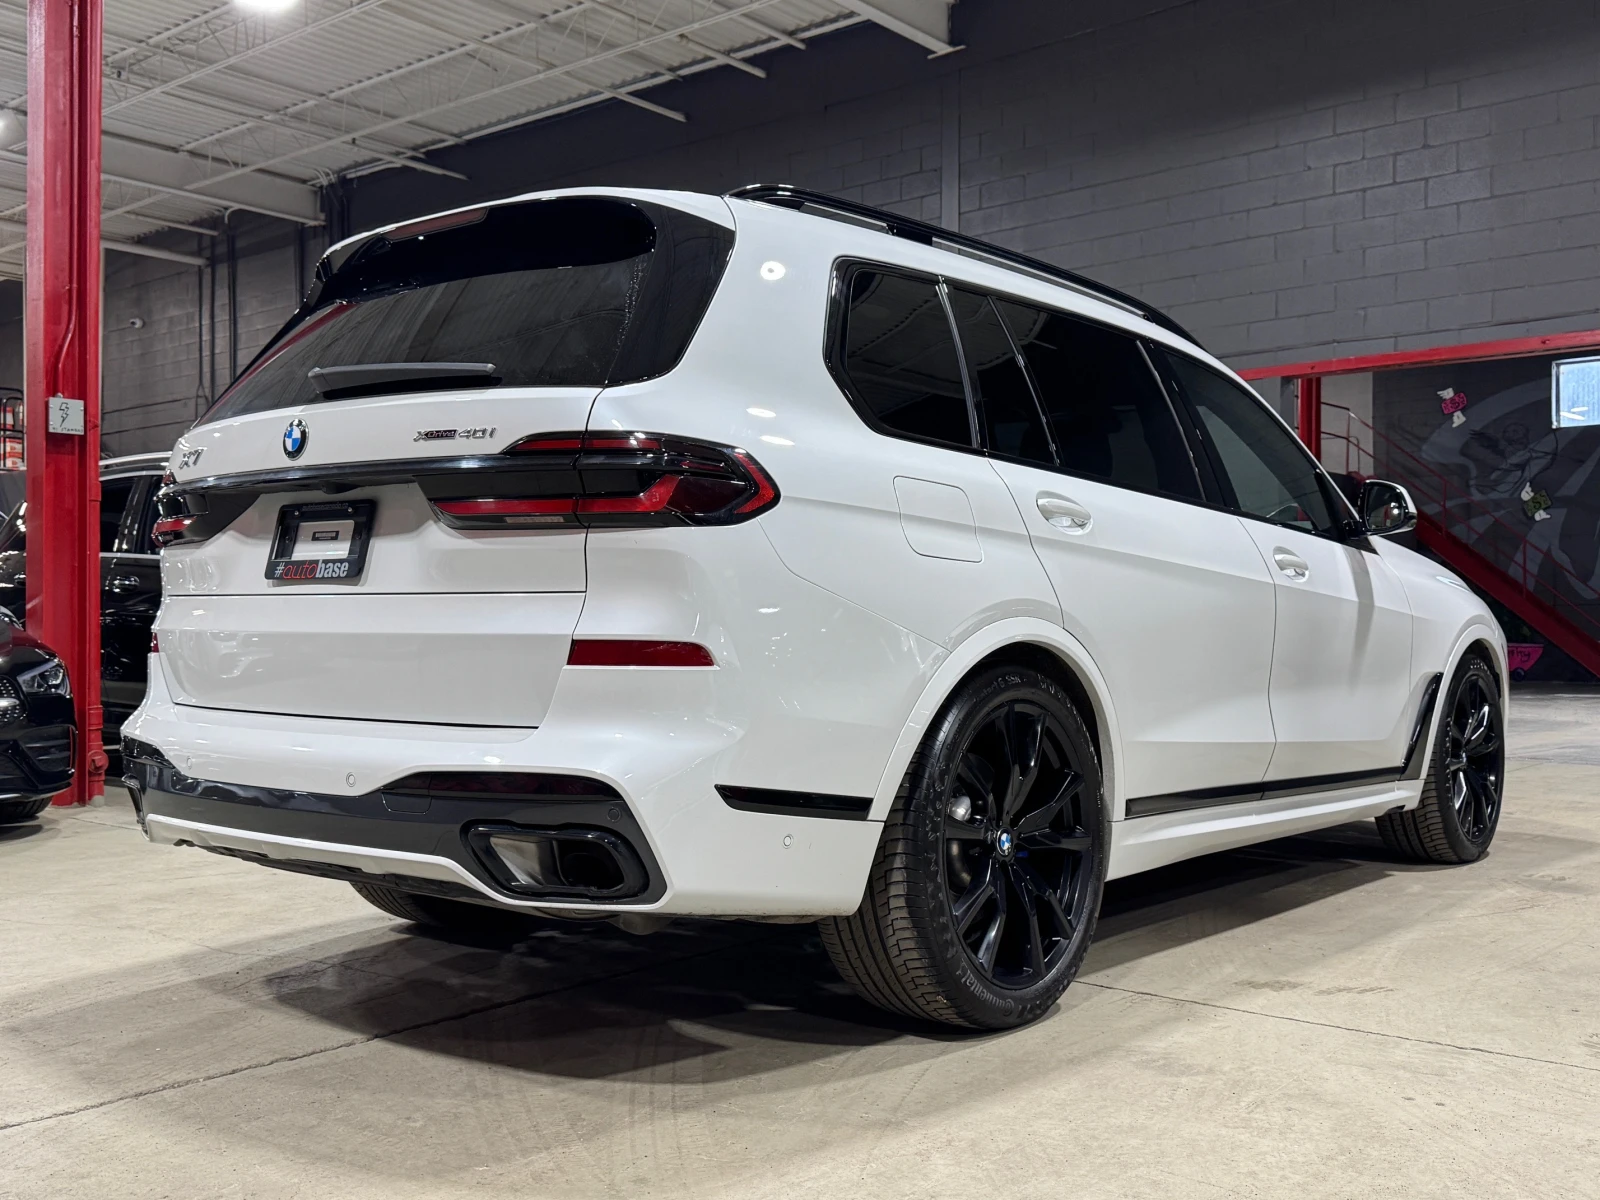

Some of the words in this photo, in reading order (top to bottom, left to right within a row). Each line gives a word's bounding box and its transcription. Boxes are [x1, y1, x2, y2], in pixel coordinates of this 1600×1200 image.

[178, 446, 206, 470] X7
[274, 558, 349, 579] #autobase
[961, 969, 1015, 1017] Continental
